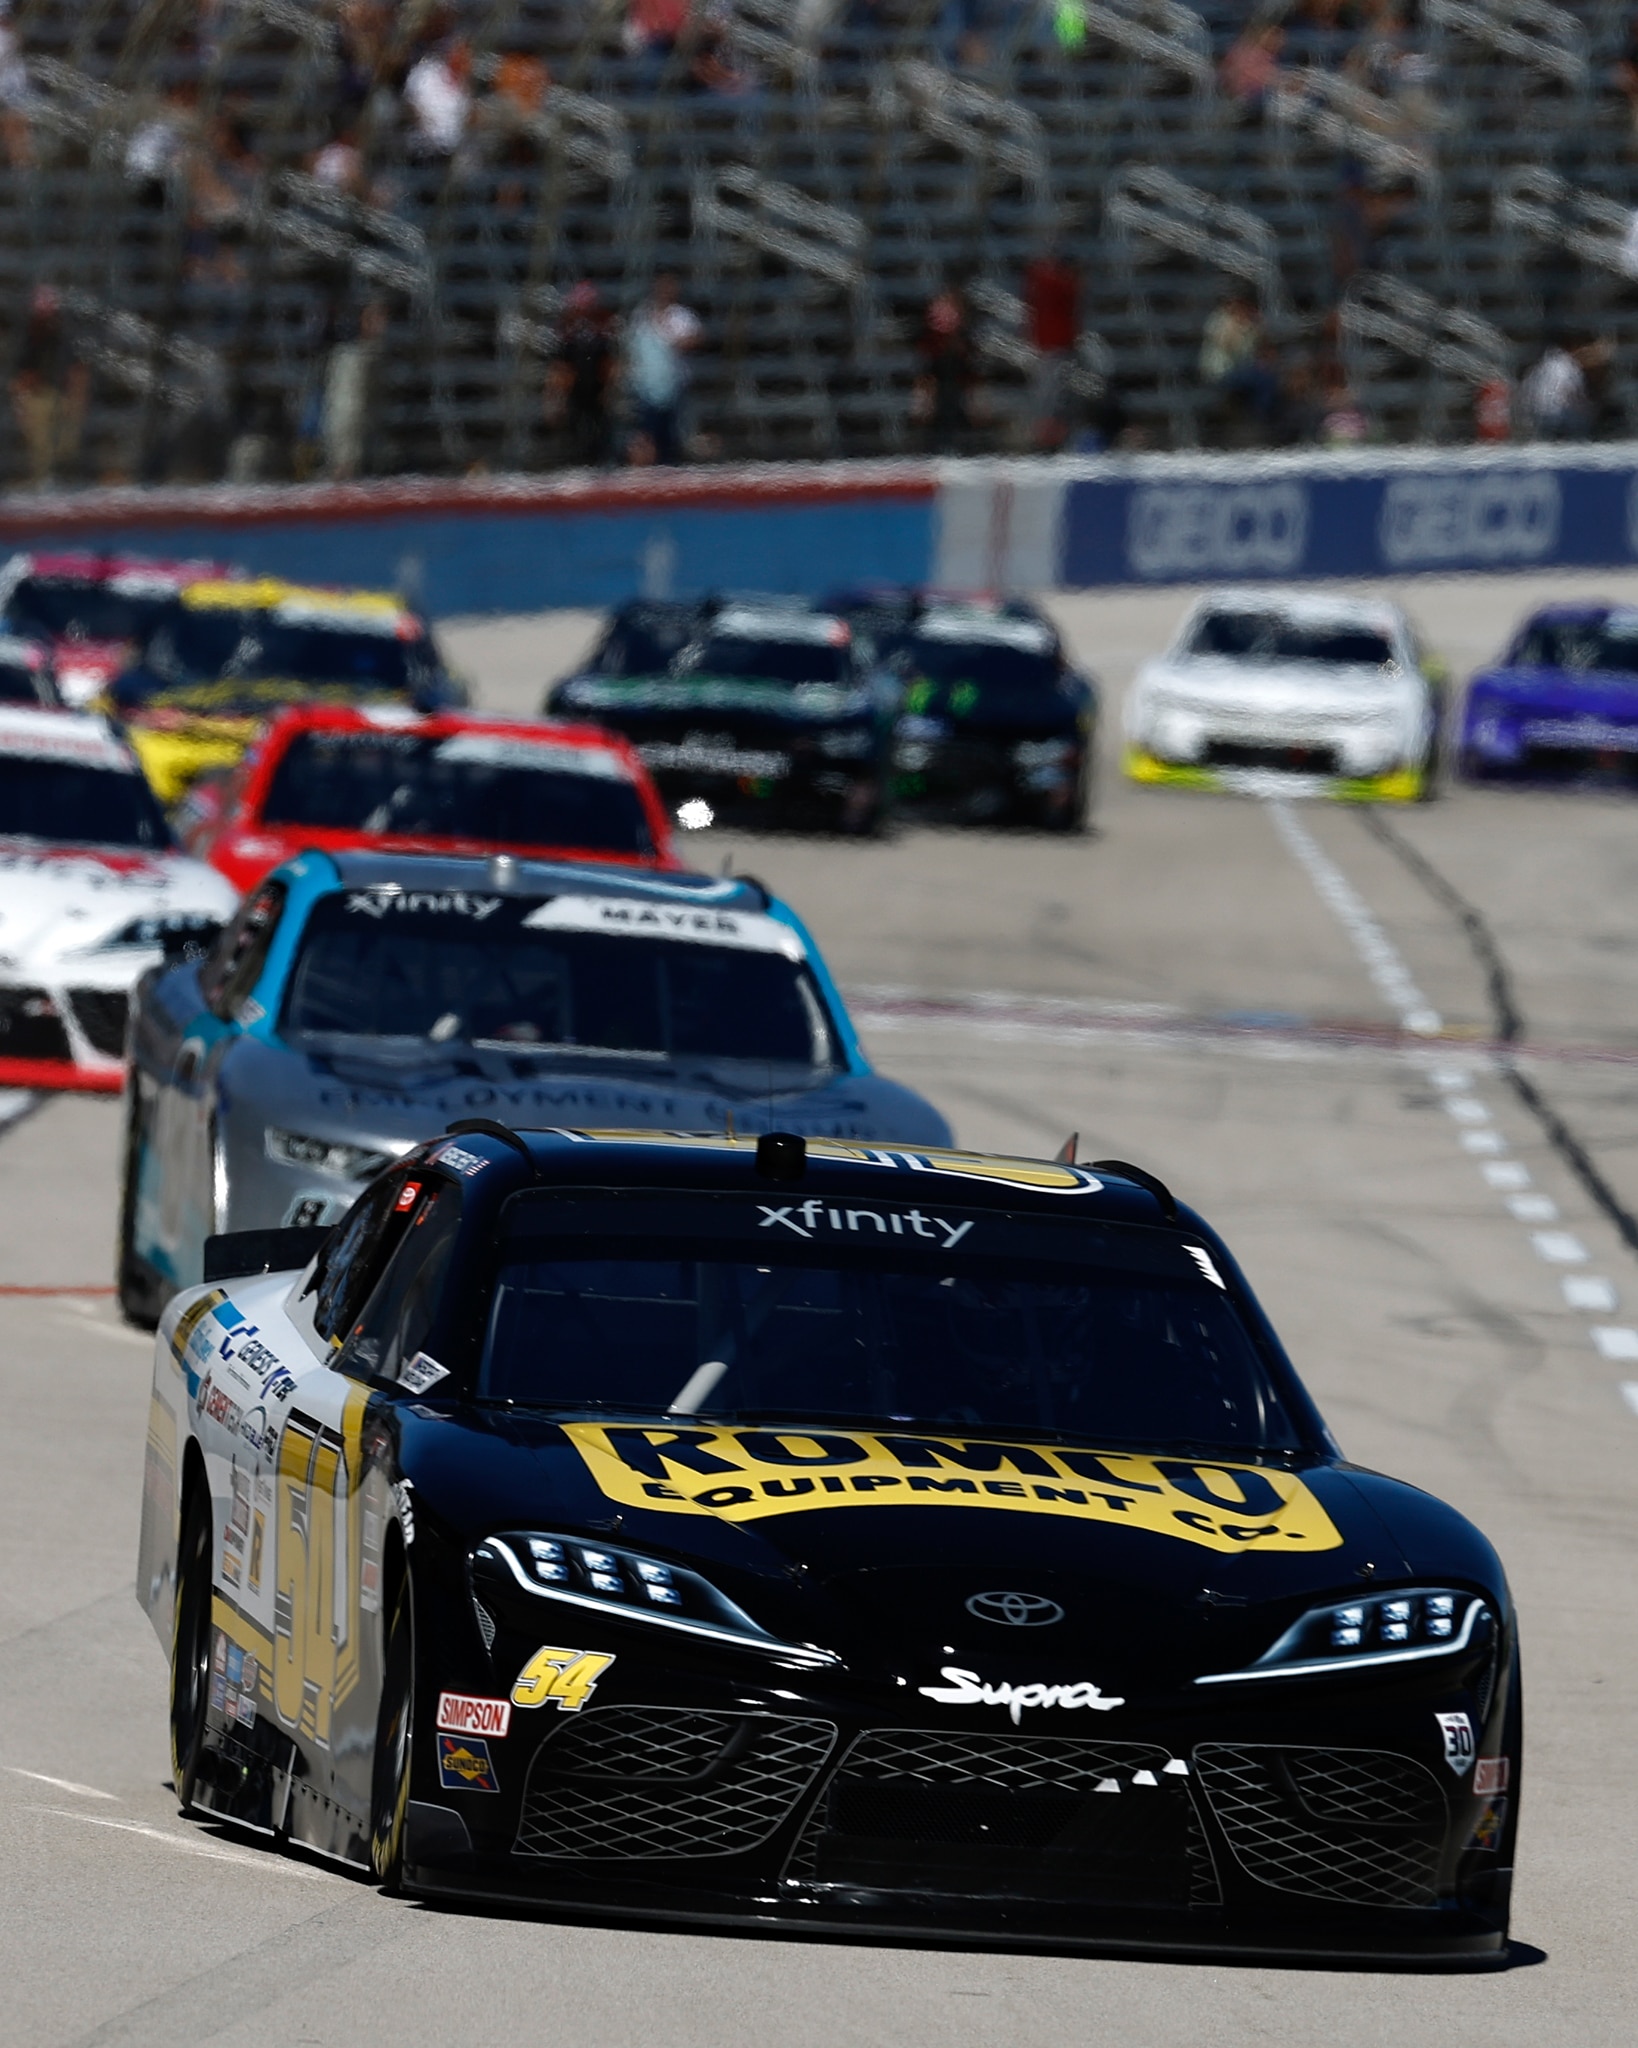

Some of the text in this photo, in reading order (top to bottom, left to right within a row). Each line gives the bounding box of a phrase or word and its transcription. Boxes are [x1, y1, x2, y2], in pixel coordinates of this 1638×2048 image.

[344, 887, 501, 920] xfinity
[603, 906, 738, 934] MAYER
[756, 1200, 976, 1248] xfinity
[602, 1426, 1289, 1517] ROMCO
[642, 1474, 1136, 1513] EQUIPMENT
[1173, 1509, 1307, 1541] CO.
[510, 1645, 616, 1711] 54
[918, 1667, 1125, 1725] Supra
[441, 1697, 505, 1731] SIMPSON
[1444, 1726, 1471, 1757] 30
[445, 1755, 486, 1772] SUNOCO
